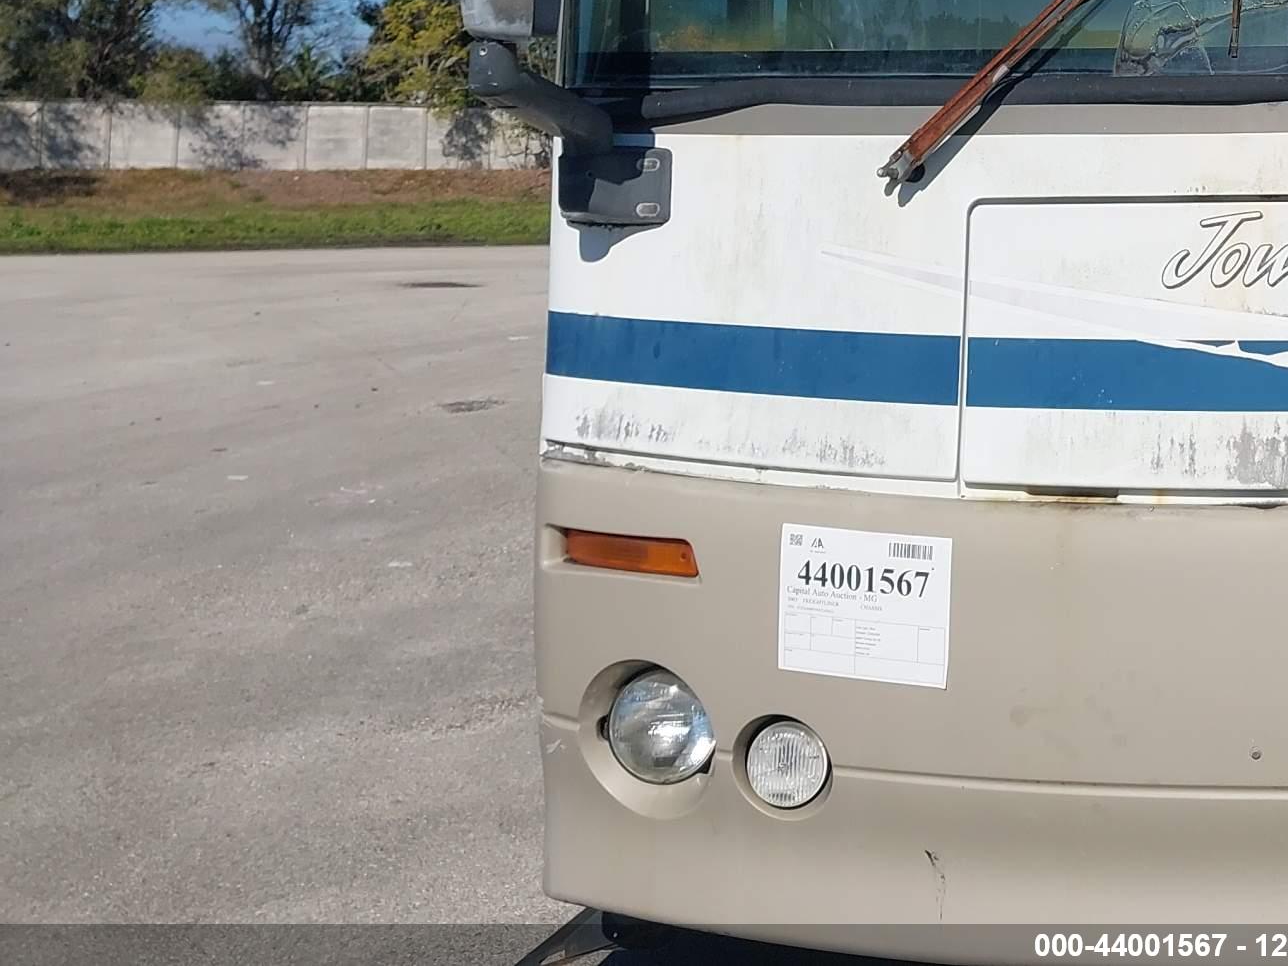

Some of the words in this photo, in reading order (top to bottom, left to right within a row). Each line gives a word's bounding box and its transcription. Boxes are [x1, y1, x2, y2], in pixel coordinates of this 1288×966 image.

[797, 559, 930, 598] 44001567
[786, 585, 811, 596] Capital
[812, 588, 829, 597] Auto
[830, 591, 857, 601] Auction
[863, 594, 878, 603] MG
